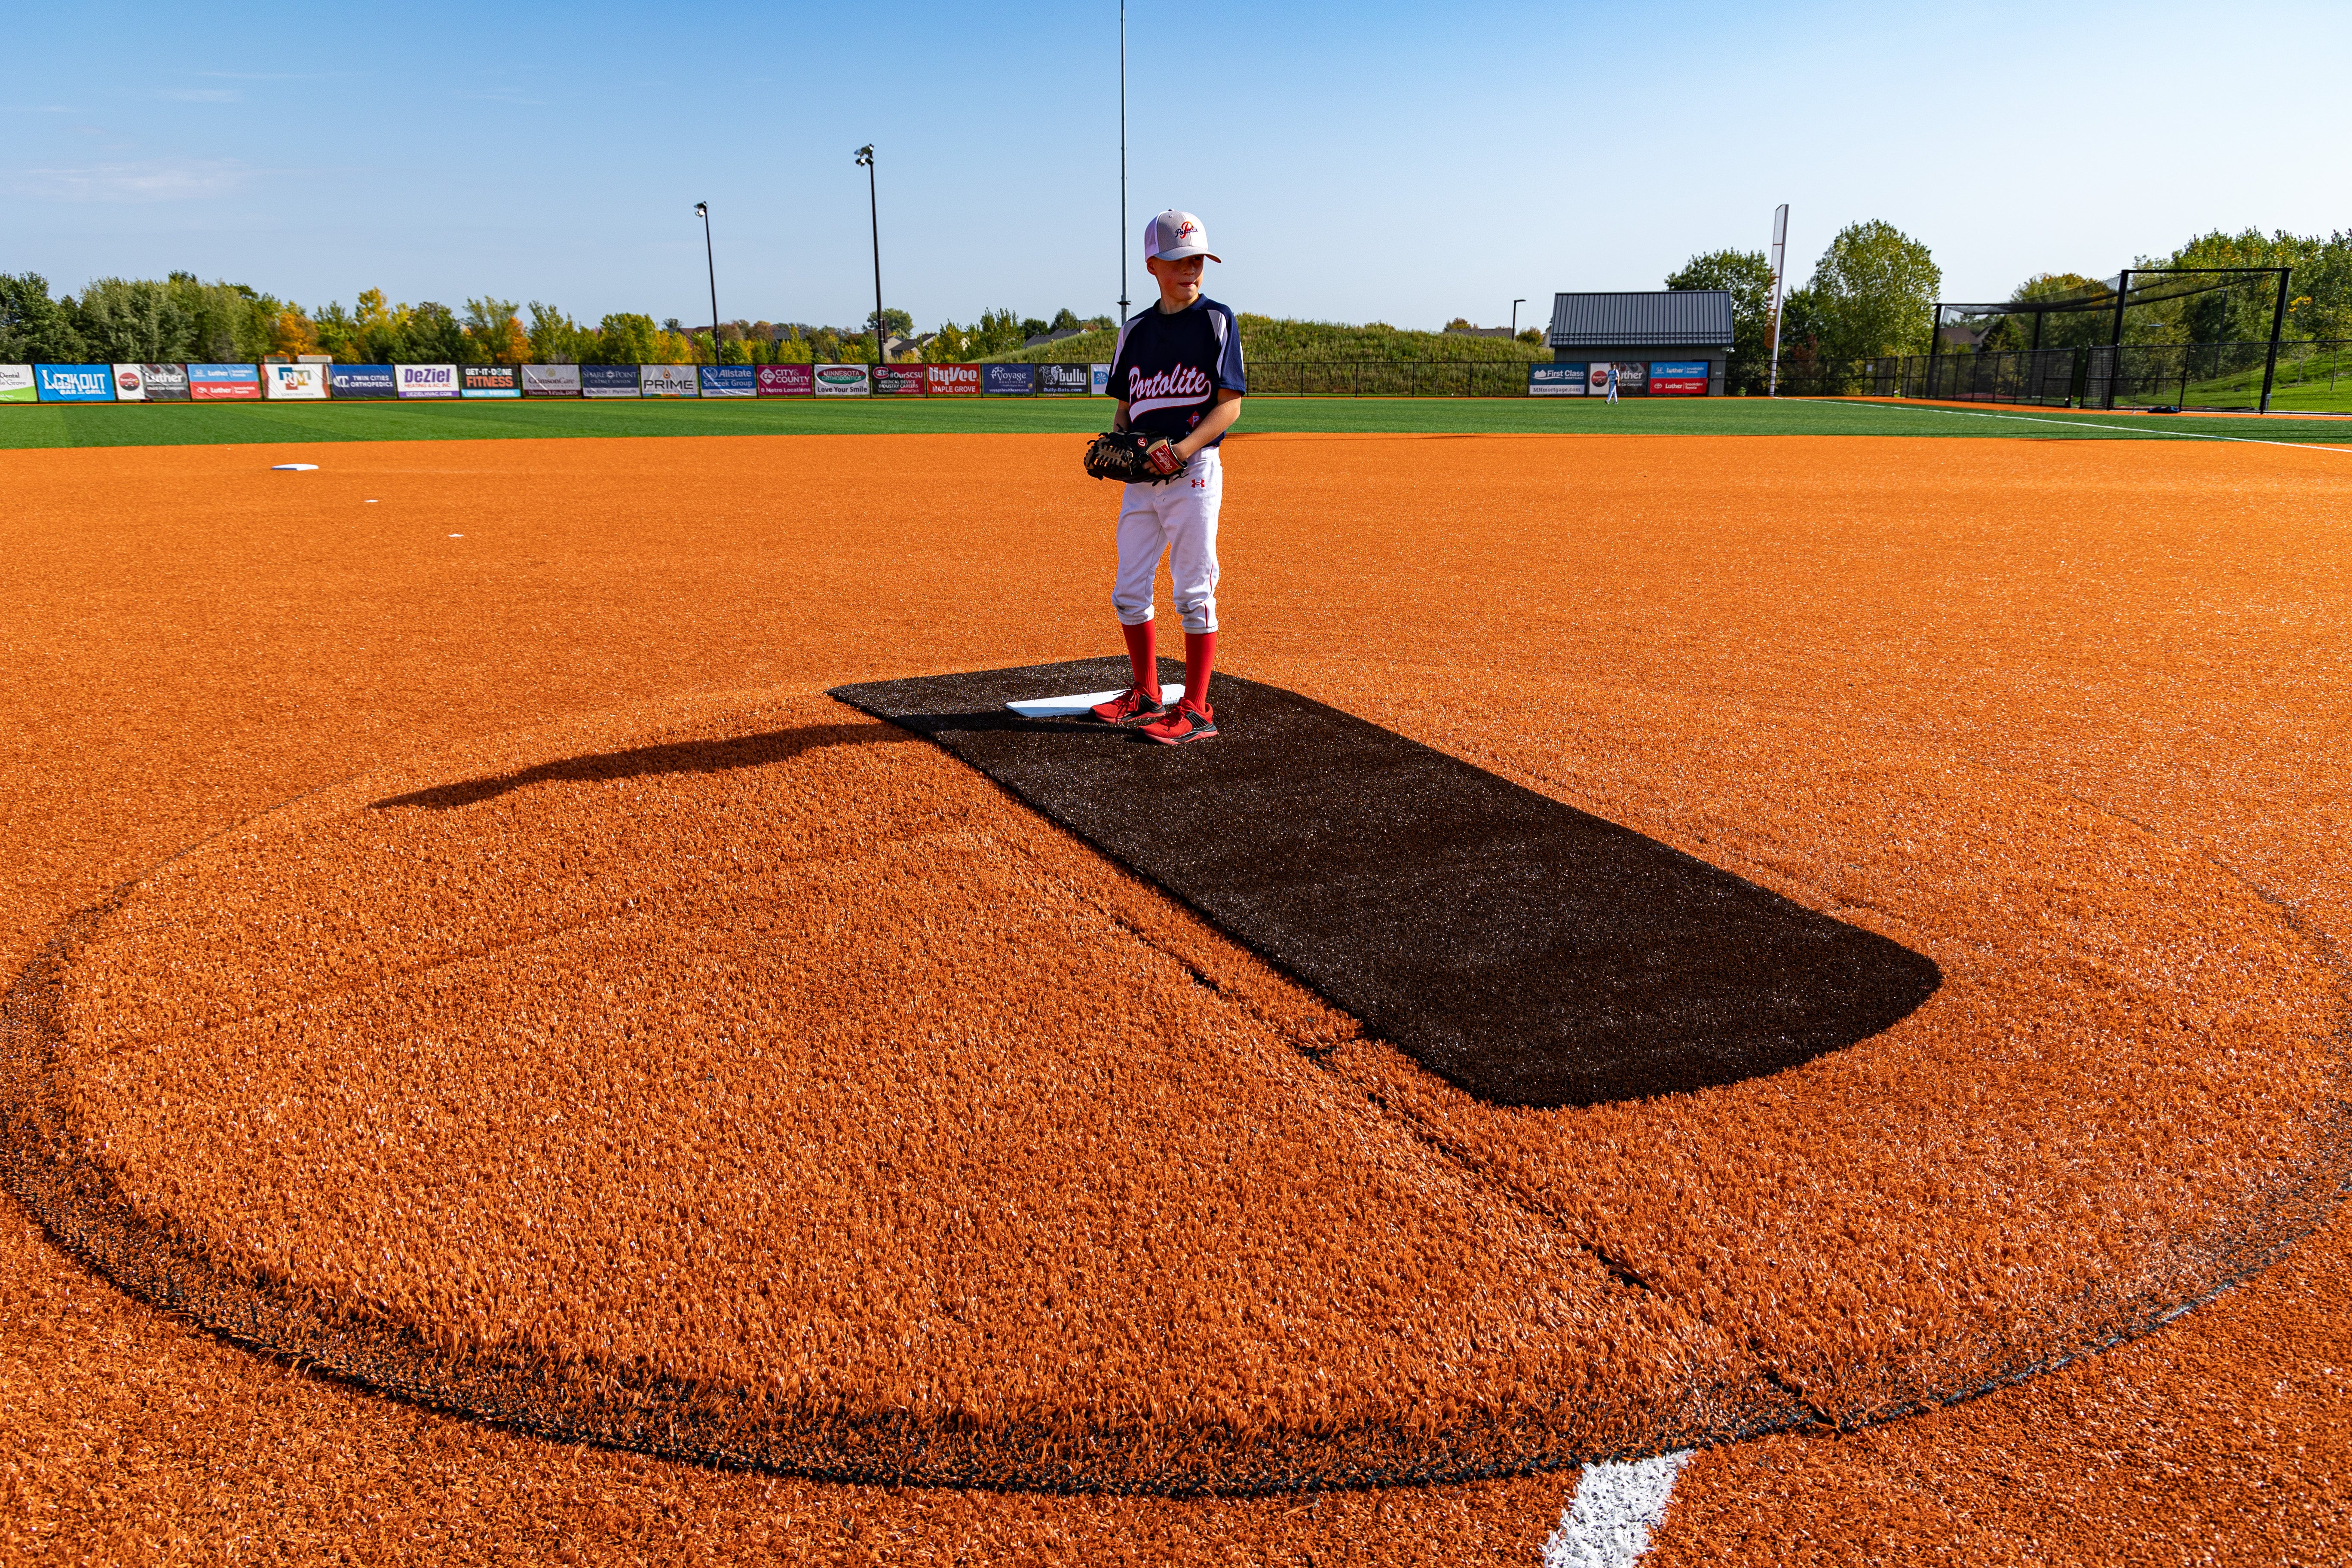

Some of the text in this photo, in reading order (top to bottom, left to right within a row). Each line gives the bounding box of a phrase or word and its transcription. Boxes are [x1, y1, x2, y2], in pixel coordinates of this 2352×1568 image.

[146, 373, 183, 383] Luther
[404, 368, 450, 383] DeZiel
[718, 369, 751, 377] Allstate
[997, 372, 1026, 381] Voyage
[1059, 369, 1086, 385] bully
[1620, 370, 1643, 380] uther
[42, 370, 106, 392] LOOKOUT
[466, 376, 513, 387] FITNESS
[643, 380, 694, 389] PRIME
[1128, 363, 1210, 406] Portolite
[1155, 451, 1173, 469] Rawlings
